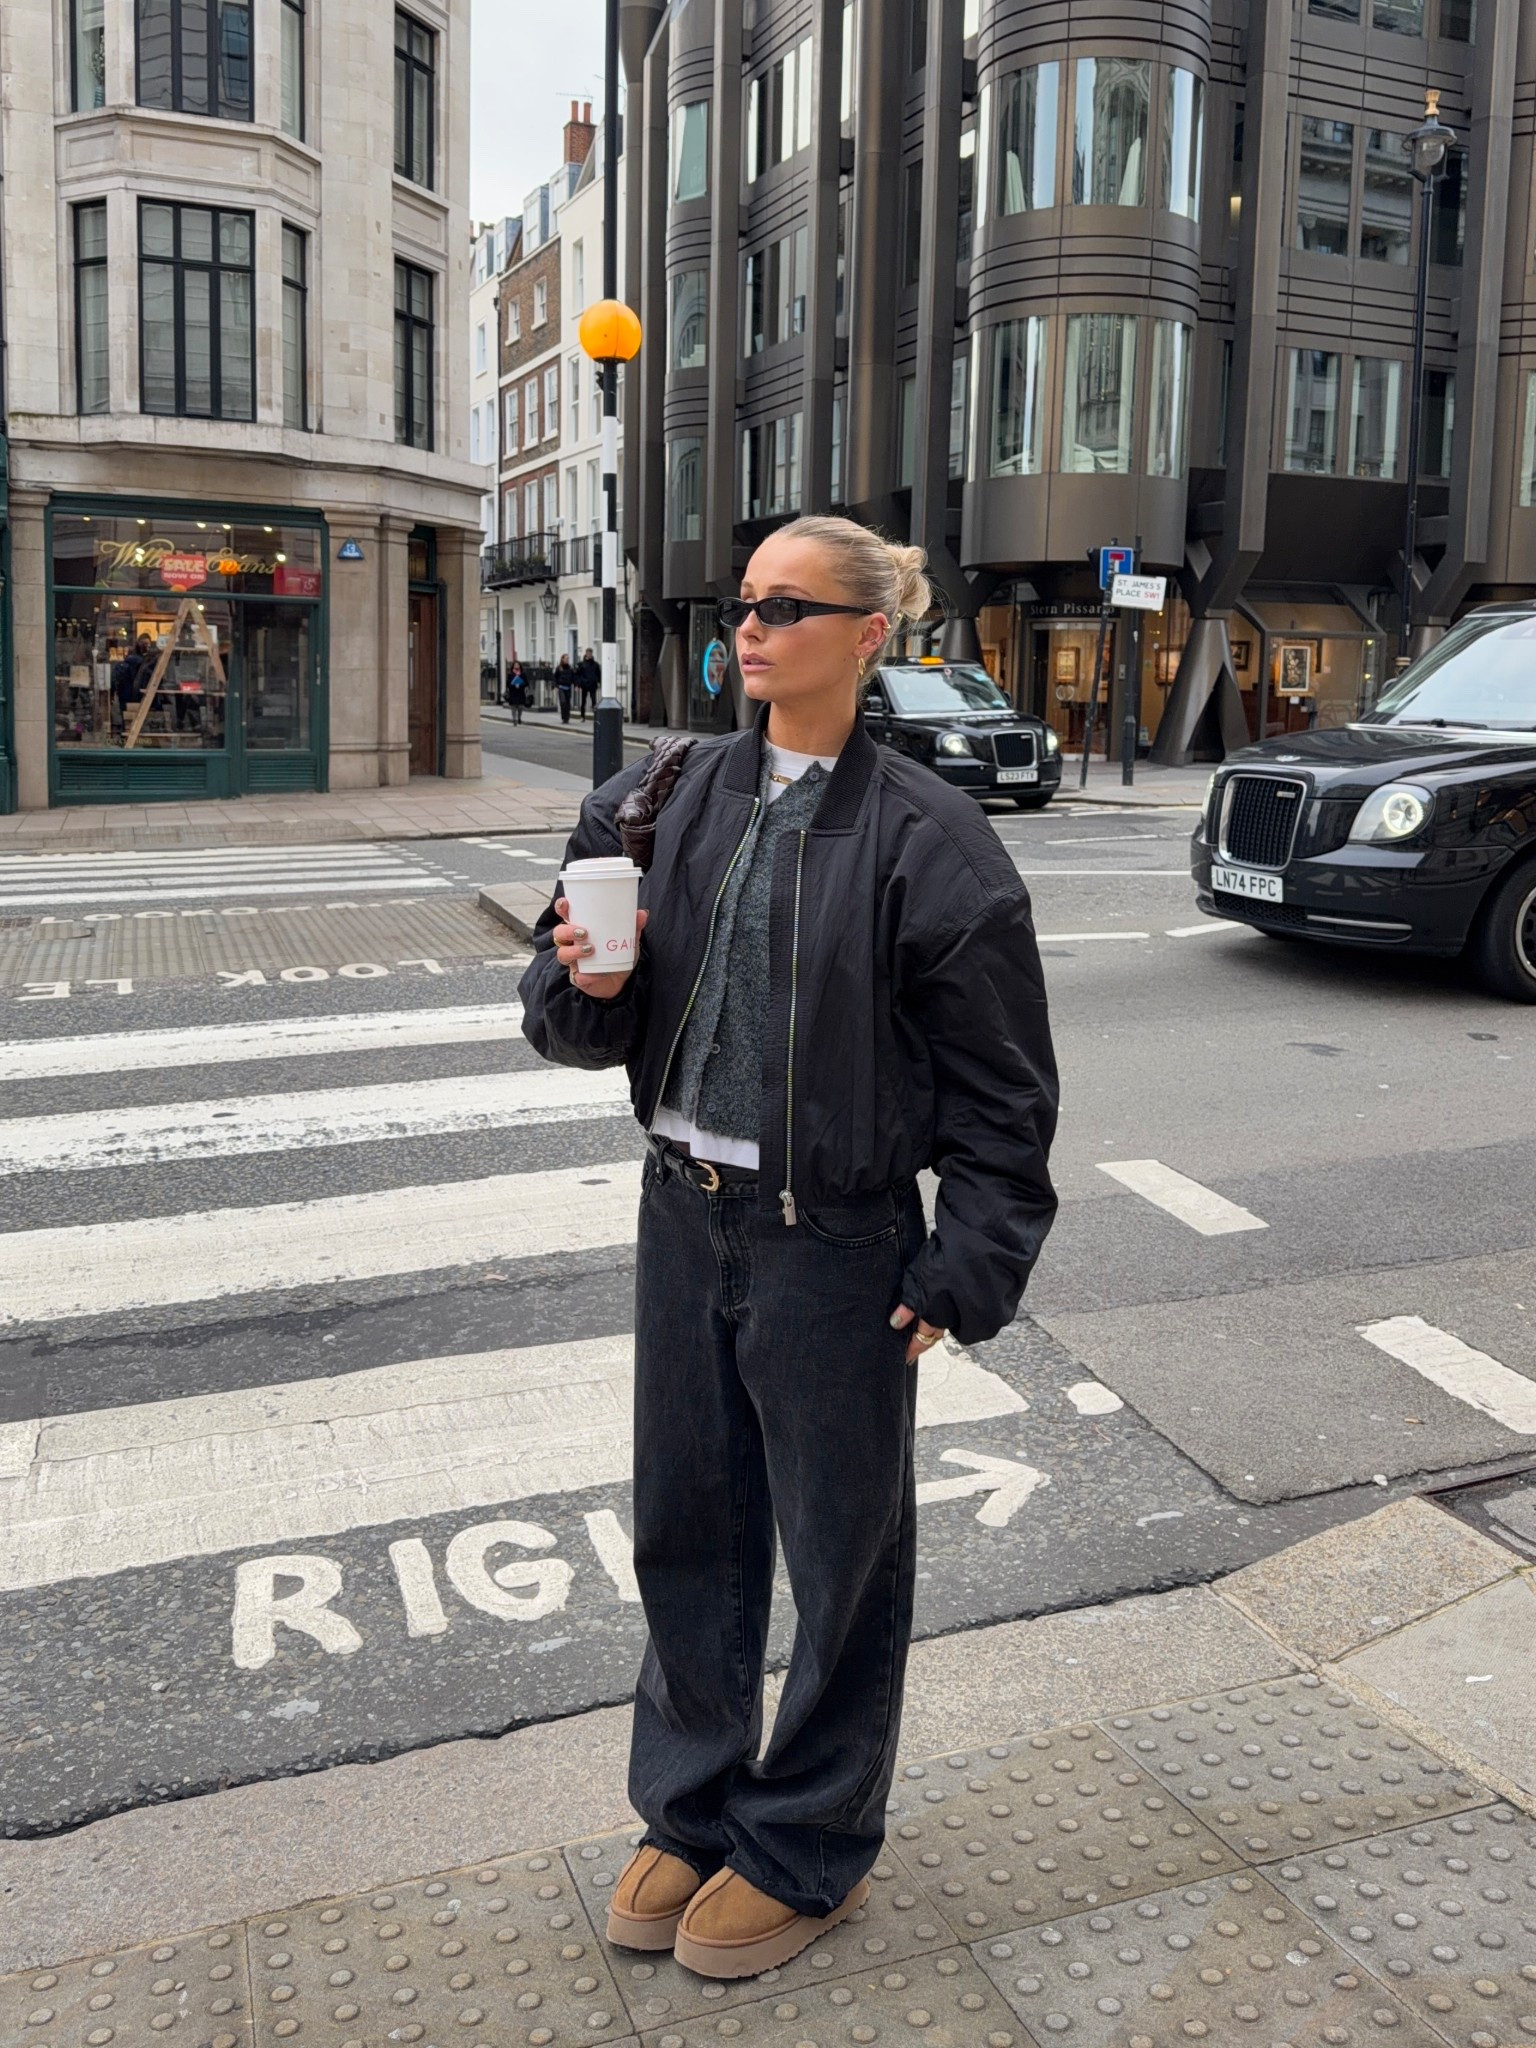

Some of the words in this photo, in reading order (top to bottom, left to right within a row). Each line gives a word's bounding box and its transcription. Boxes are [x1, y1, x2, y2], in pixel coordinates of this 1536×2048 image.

[163, 558, 205, 572] SALE
[206, 547, 277, 574] Evans
[1116, 588, 1141, 598] PLACE
[1144, 592, 1160, 600] SW1
[1030, 604, 1058, 615] Stern
[1063, 602, 1115, 614] Pissaro
[1215, 868, 1246, 892] LN74
[1250, 876, 1277, 897] FPC
[215, 957, 445, 988] LOOK
